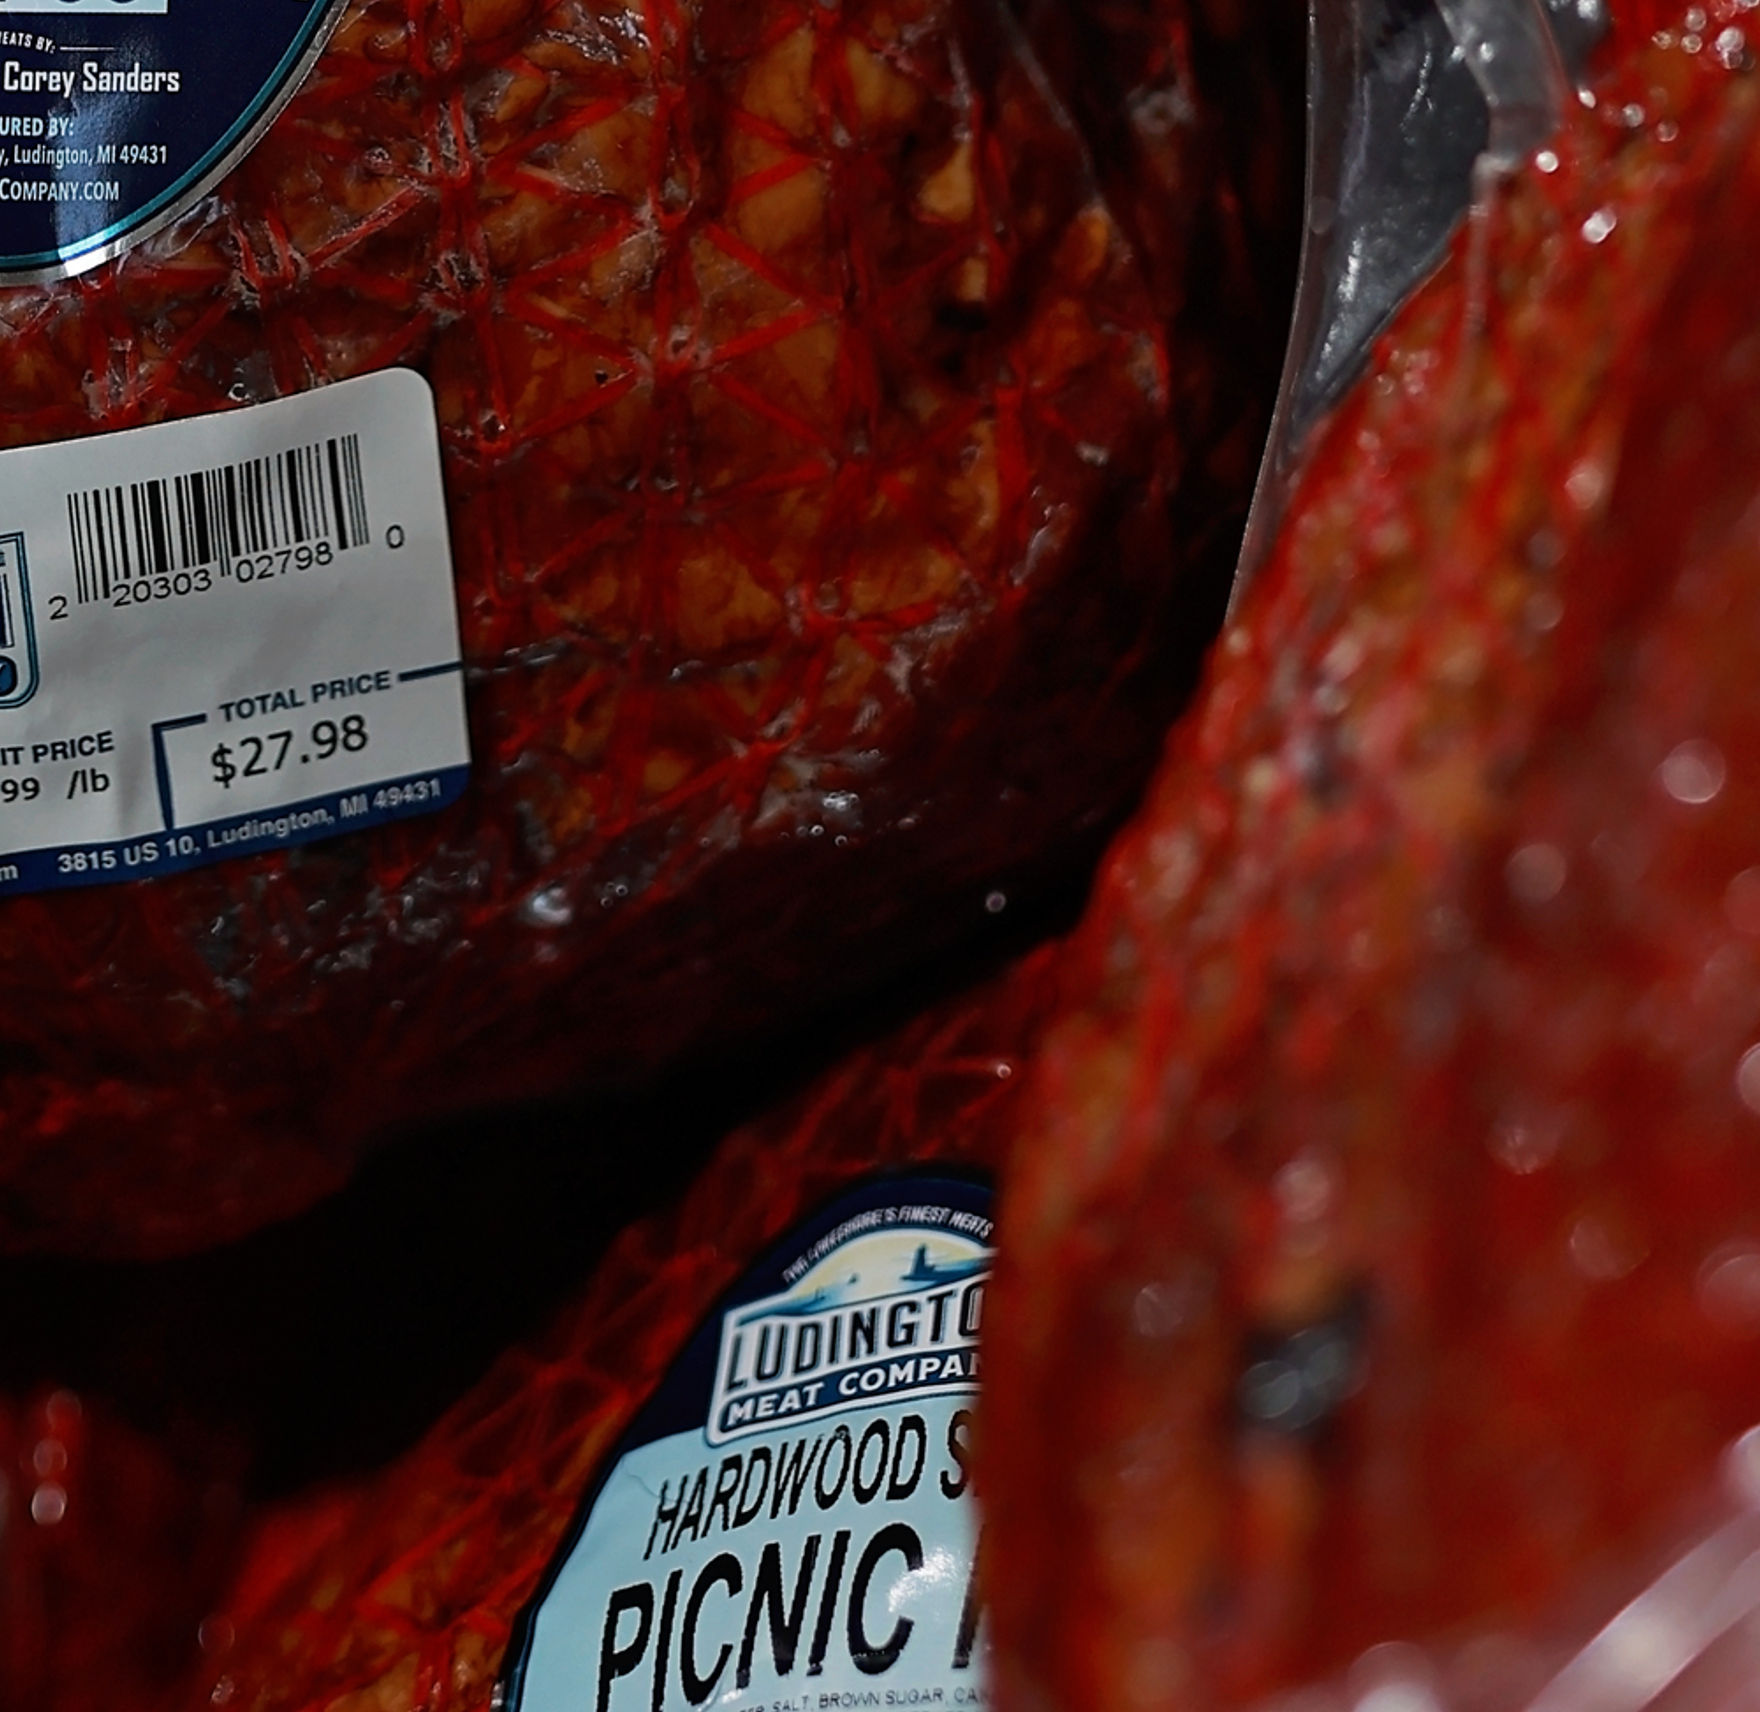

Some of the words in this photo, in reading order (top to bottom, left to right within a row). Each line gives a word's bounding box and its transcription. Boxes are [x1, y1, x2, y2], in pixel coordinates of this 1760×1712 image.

[35, 36, 56, 54] BY:
[3, 61, 75, 97] Corey
[82, 62, 180, 93] Sanders
[47, 117, 74, 137] BY:
[14, 144, 93, 168] Ludington,
[97, 145, 116, 163] MI
[120, 145, 167, 164] 49431
[48, 595, 69, 621] 2
[112, 568, 213, 608] 20303
[235, 541, 334, 584] 02798
[385, 524, 405, 550] 0
[219, 689, 305, 723] TOTAL
[311, 670, 392, 705] PRICE
[32, 730, 116, 763] PRICE
[210, 714, 369, 789] $27.98
[57, 846, 117, 869] 3815
[123, 841, 160, 865] US
[167, 834, 201, 857] 10,
[207, 804, 335, 849] Ludington,
[340, 796, 369, 818] MI
[373, 777, 441, 809] 49431
[727, 1279, 985, 1391] LUDINGTO
[727, 1382, 825, 1426] MEAT
[643, 1414, 928, 1561] HARDWOOD
[596, 1522, 925, 1712] PICNIC
[818, 1690, 881, 1709] BROWN
